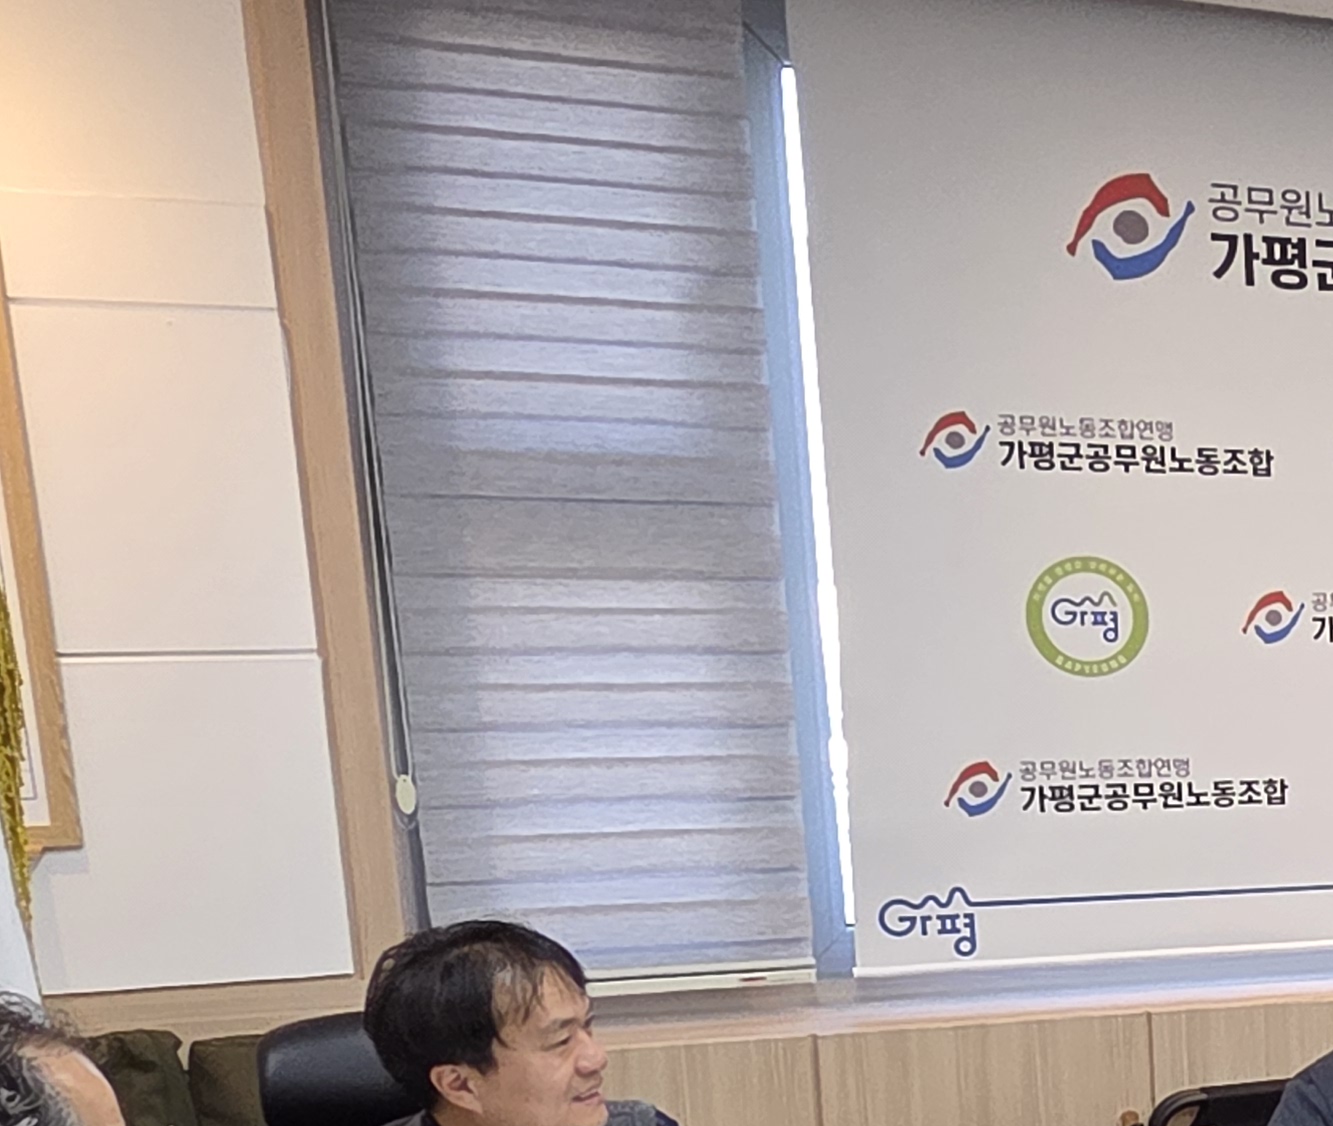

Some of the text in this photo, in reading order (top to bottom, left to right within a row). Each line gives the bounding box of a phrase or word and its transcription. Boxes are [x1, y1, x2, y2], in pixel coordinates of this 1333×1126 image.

[997, 414, 1174, 442] 공무원노동조합연맹
[998, 440, 1275, 478] 가평군공무원노동조합
[1019, 757, 1191, 782] 공무원노동조합연맹
[1020, 778, 1289, 813] 가평군공무원노동조합
